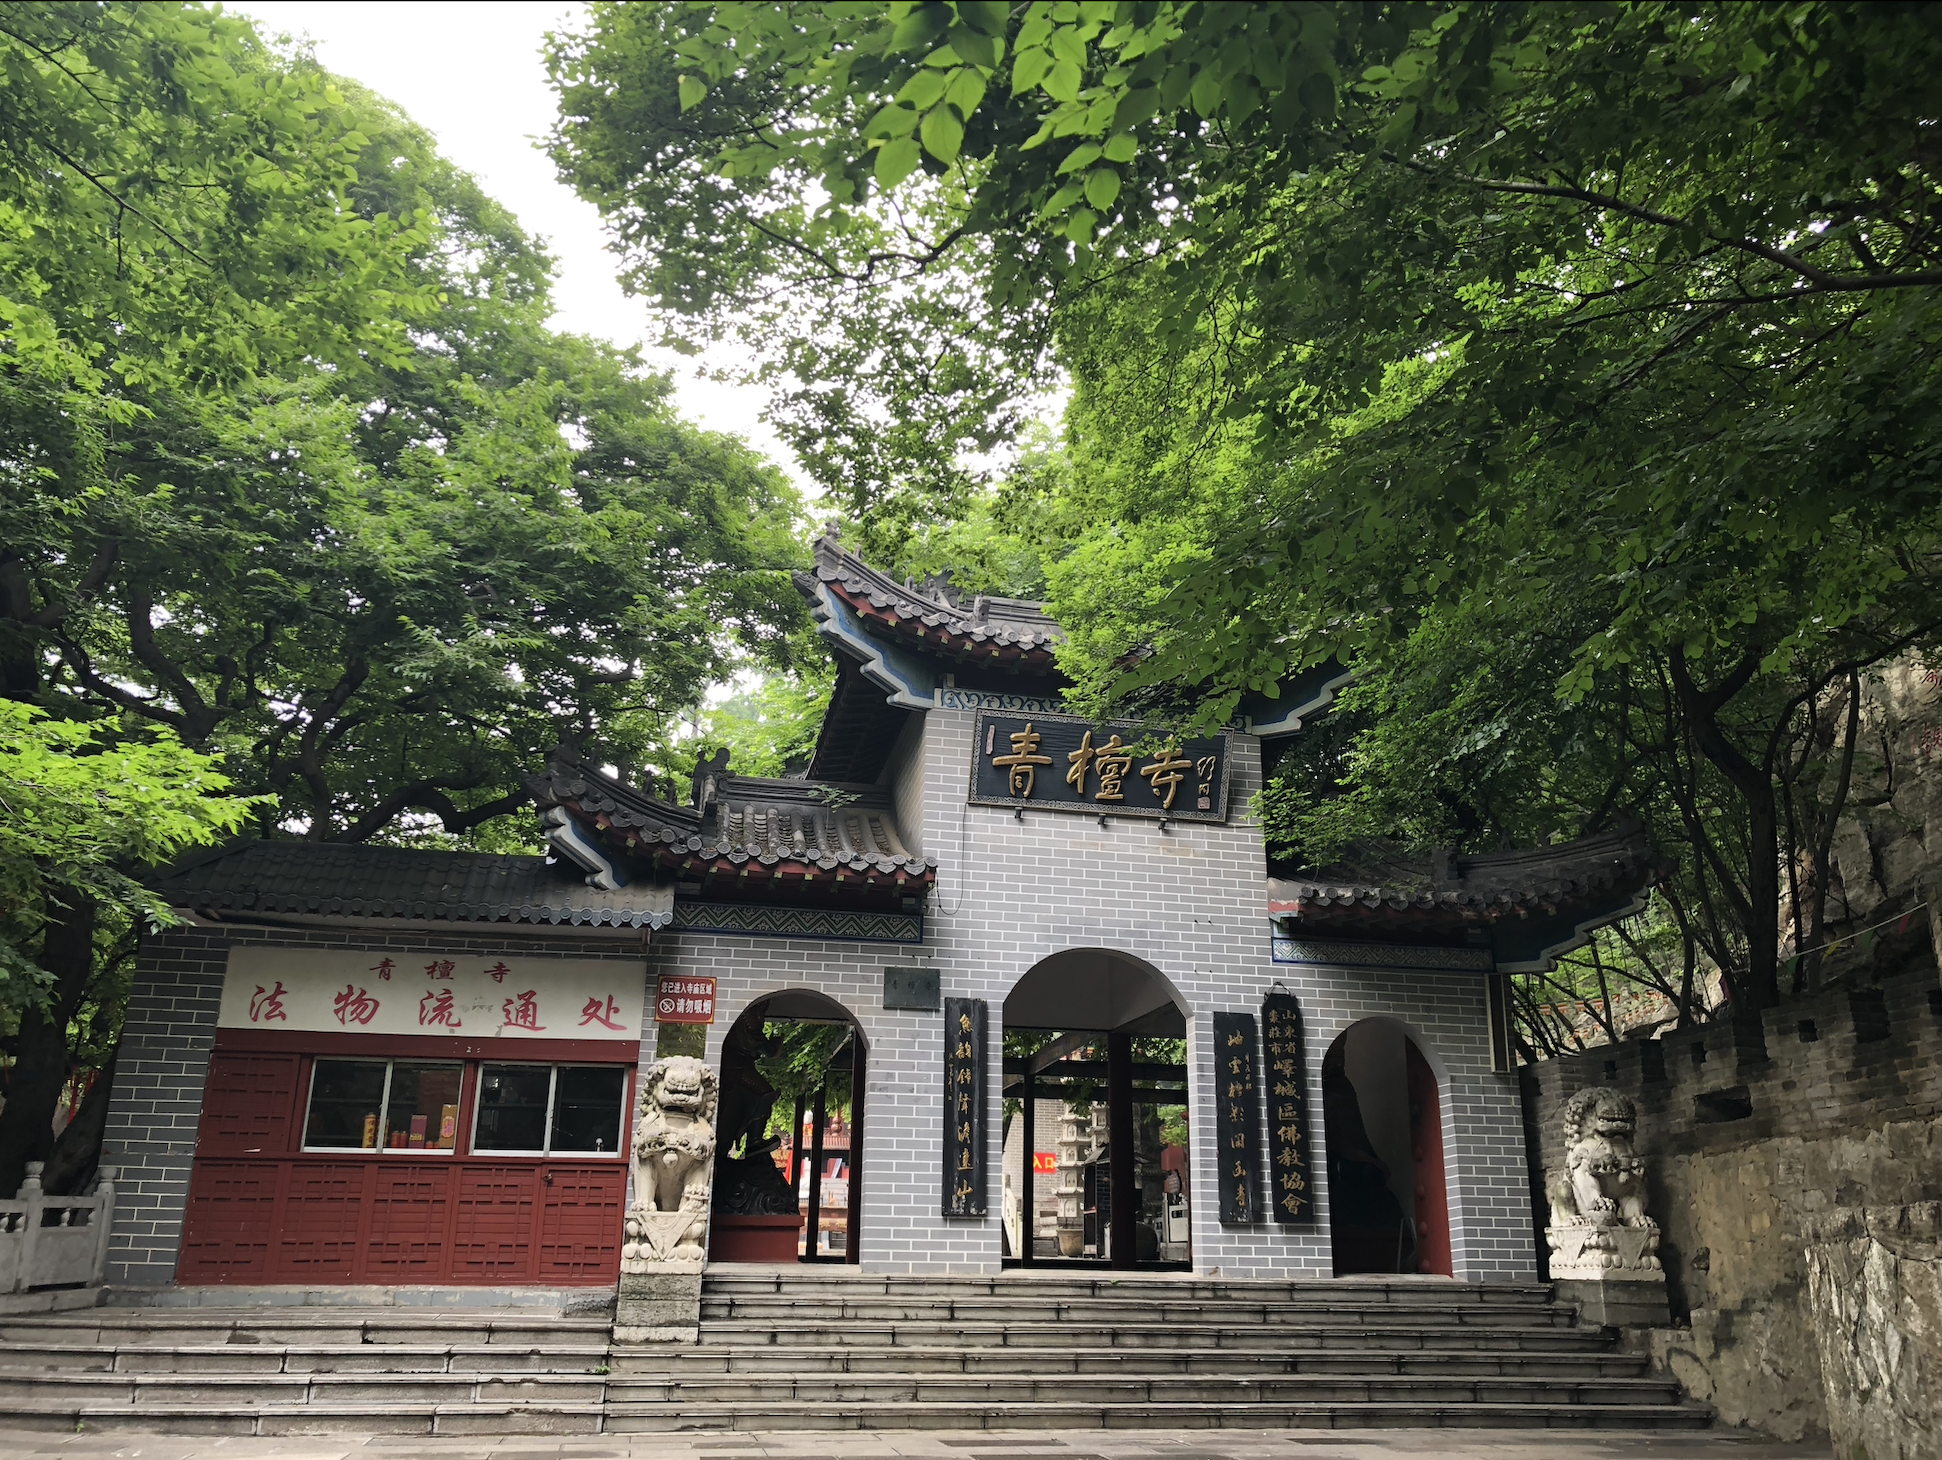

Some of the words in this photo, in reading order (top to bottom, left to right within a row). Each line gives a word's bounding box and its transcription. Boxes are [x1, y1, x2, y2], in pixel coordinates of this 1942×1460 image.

[992, 723, 1192, 809] 青檀寺
[370, 957, 511, 984] 青檀寺
[661, 981, 713, 995] 您已进入寺庙区域
[249, 981, 628, 1033] 法物流通处
[676, 998, 713, 1014] 请勿吸烟
[1281, 1009, 1298, 1055] 山東省
[1033, 1155, 1054, 1169] 入口
